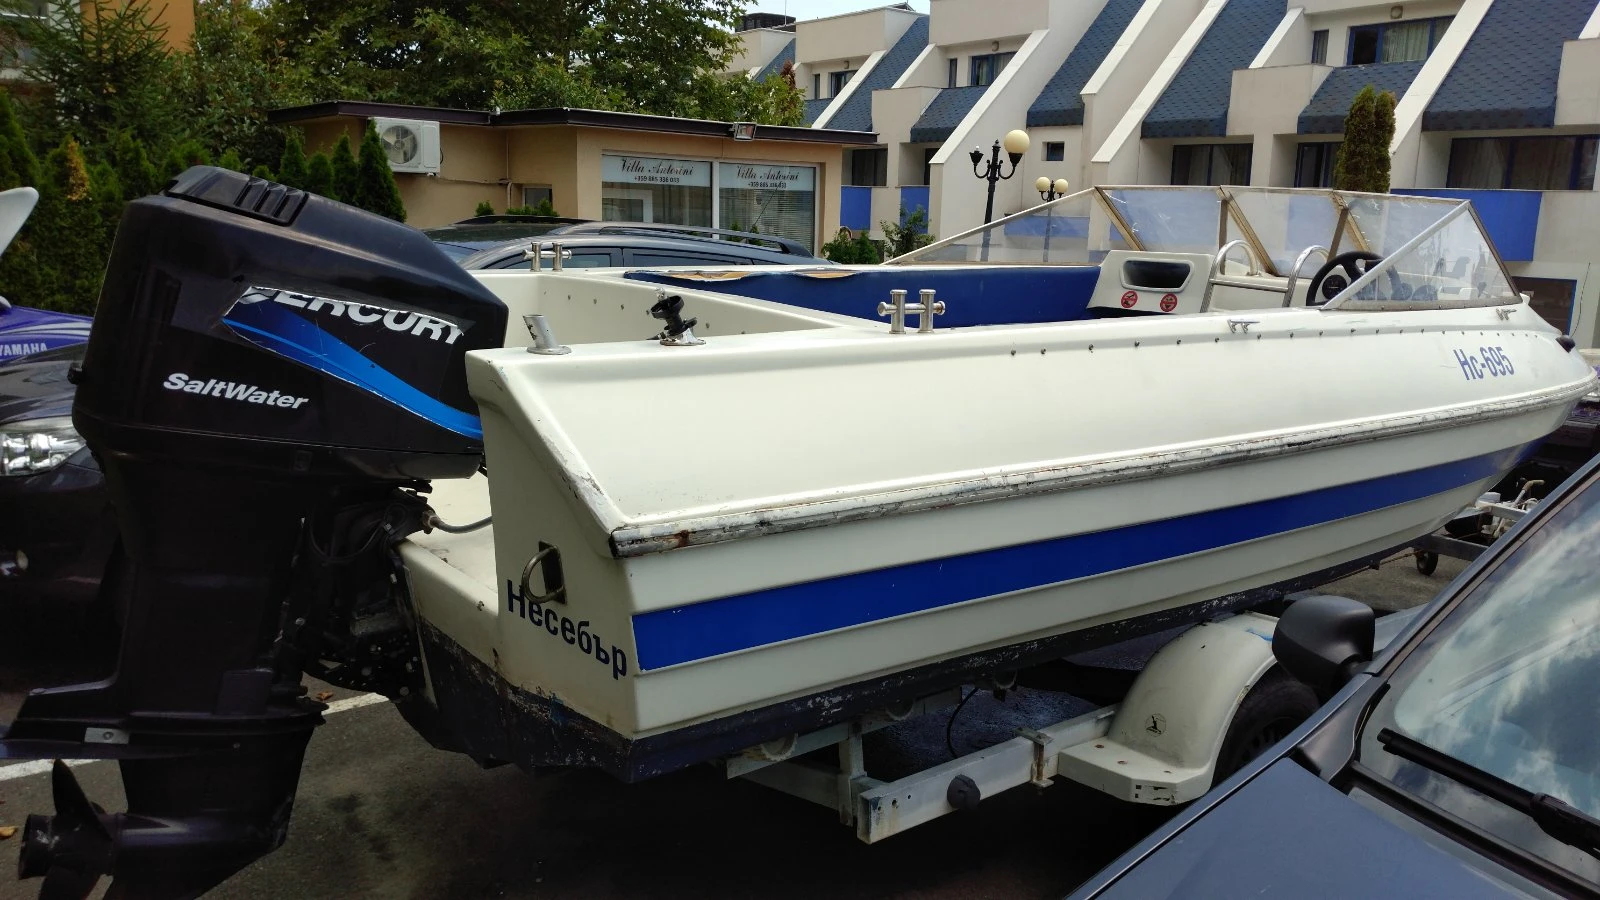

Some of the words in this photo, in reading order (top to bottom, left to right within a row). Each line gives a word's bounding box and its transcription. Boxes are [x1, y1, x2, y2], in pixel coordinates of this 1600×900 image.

[621, 157, 645, 173] Villa
[737, 166, 757, 179] Villa
[163, 372, 309, 410] SaltWater
[507, 579, 627, 681] Несебър
